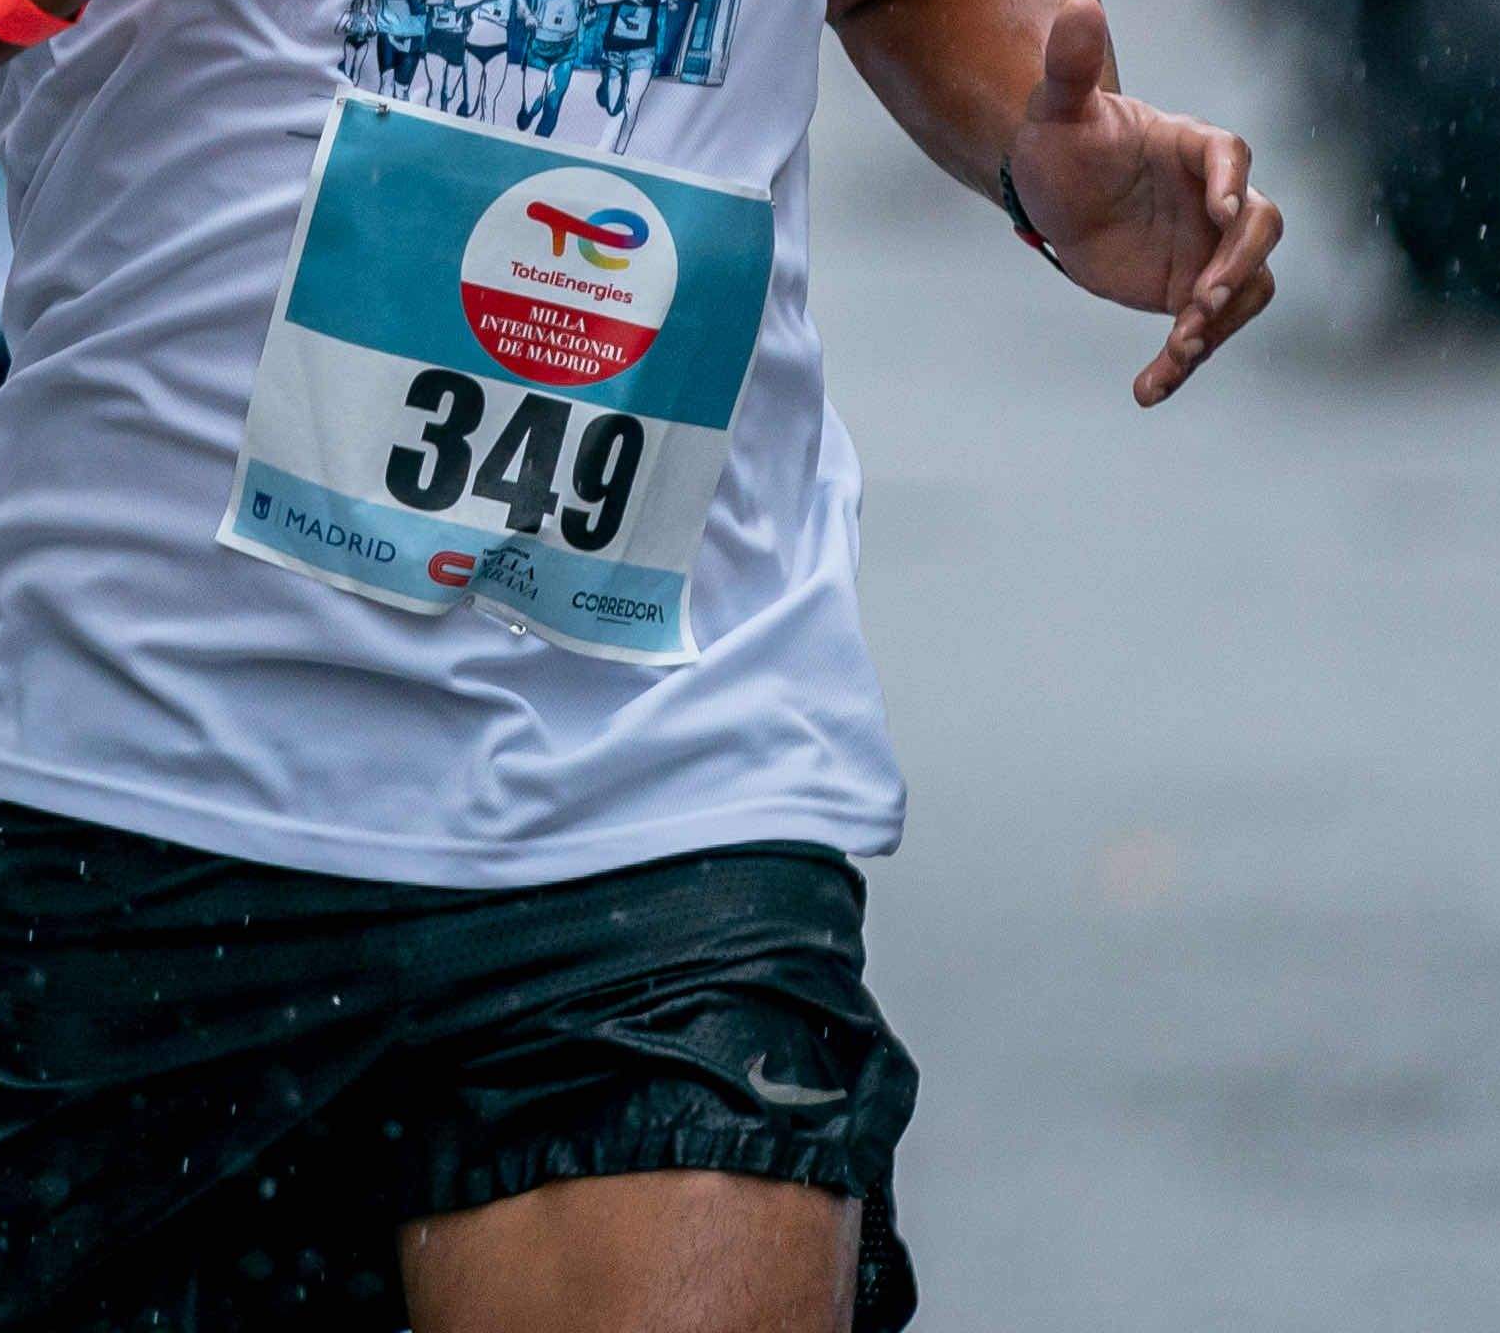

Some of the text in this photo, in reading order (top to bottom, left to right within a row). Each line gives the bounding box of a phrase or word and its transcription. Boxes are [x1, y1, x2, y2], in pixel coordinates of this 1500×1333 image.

[511, 261, 633, 304] TotalEnergies
[529, 306, 586, 333] MILLA
[497, 337, 600, 375] DE MADRID
[385, 368, 645, 552] 349
[285, 507, 397, 563] MADRID
